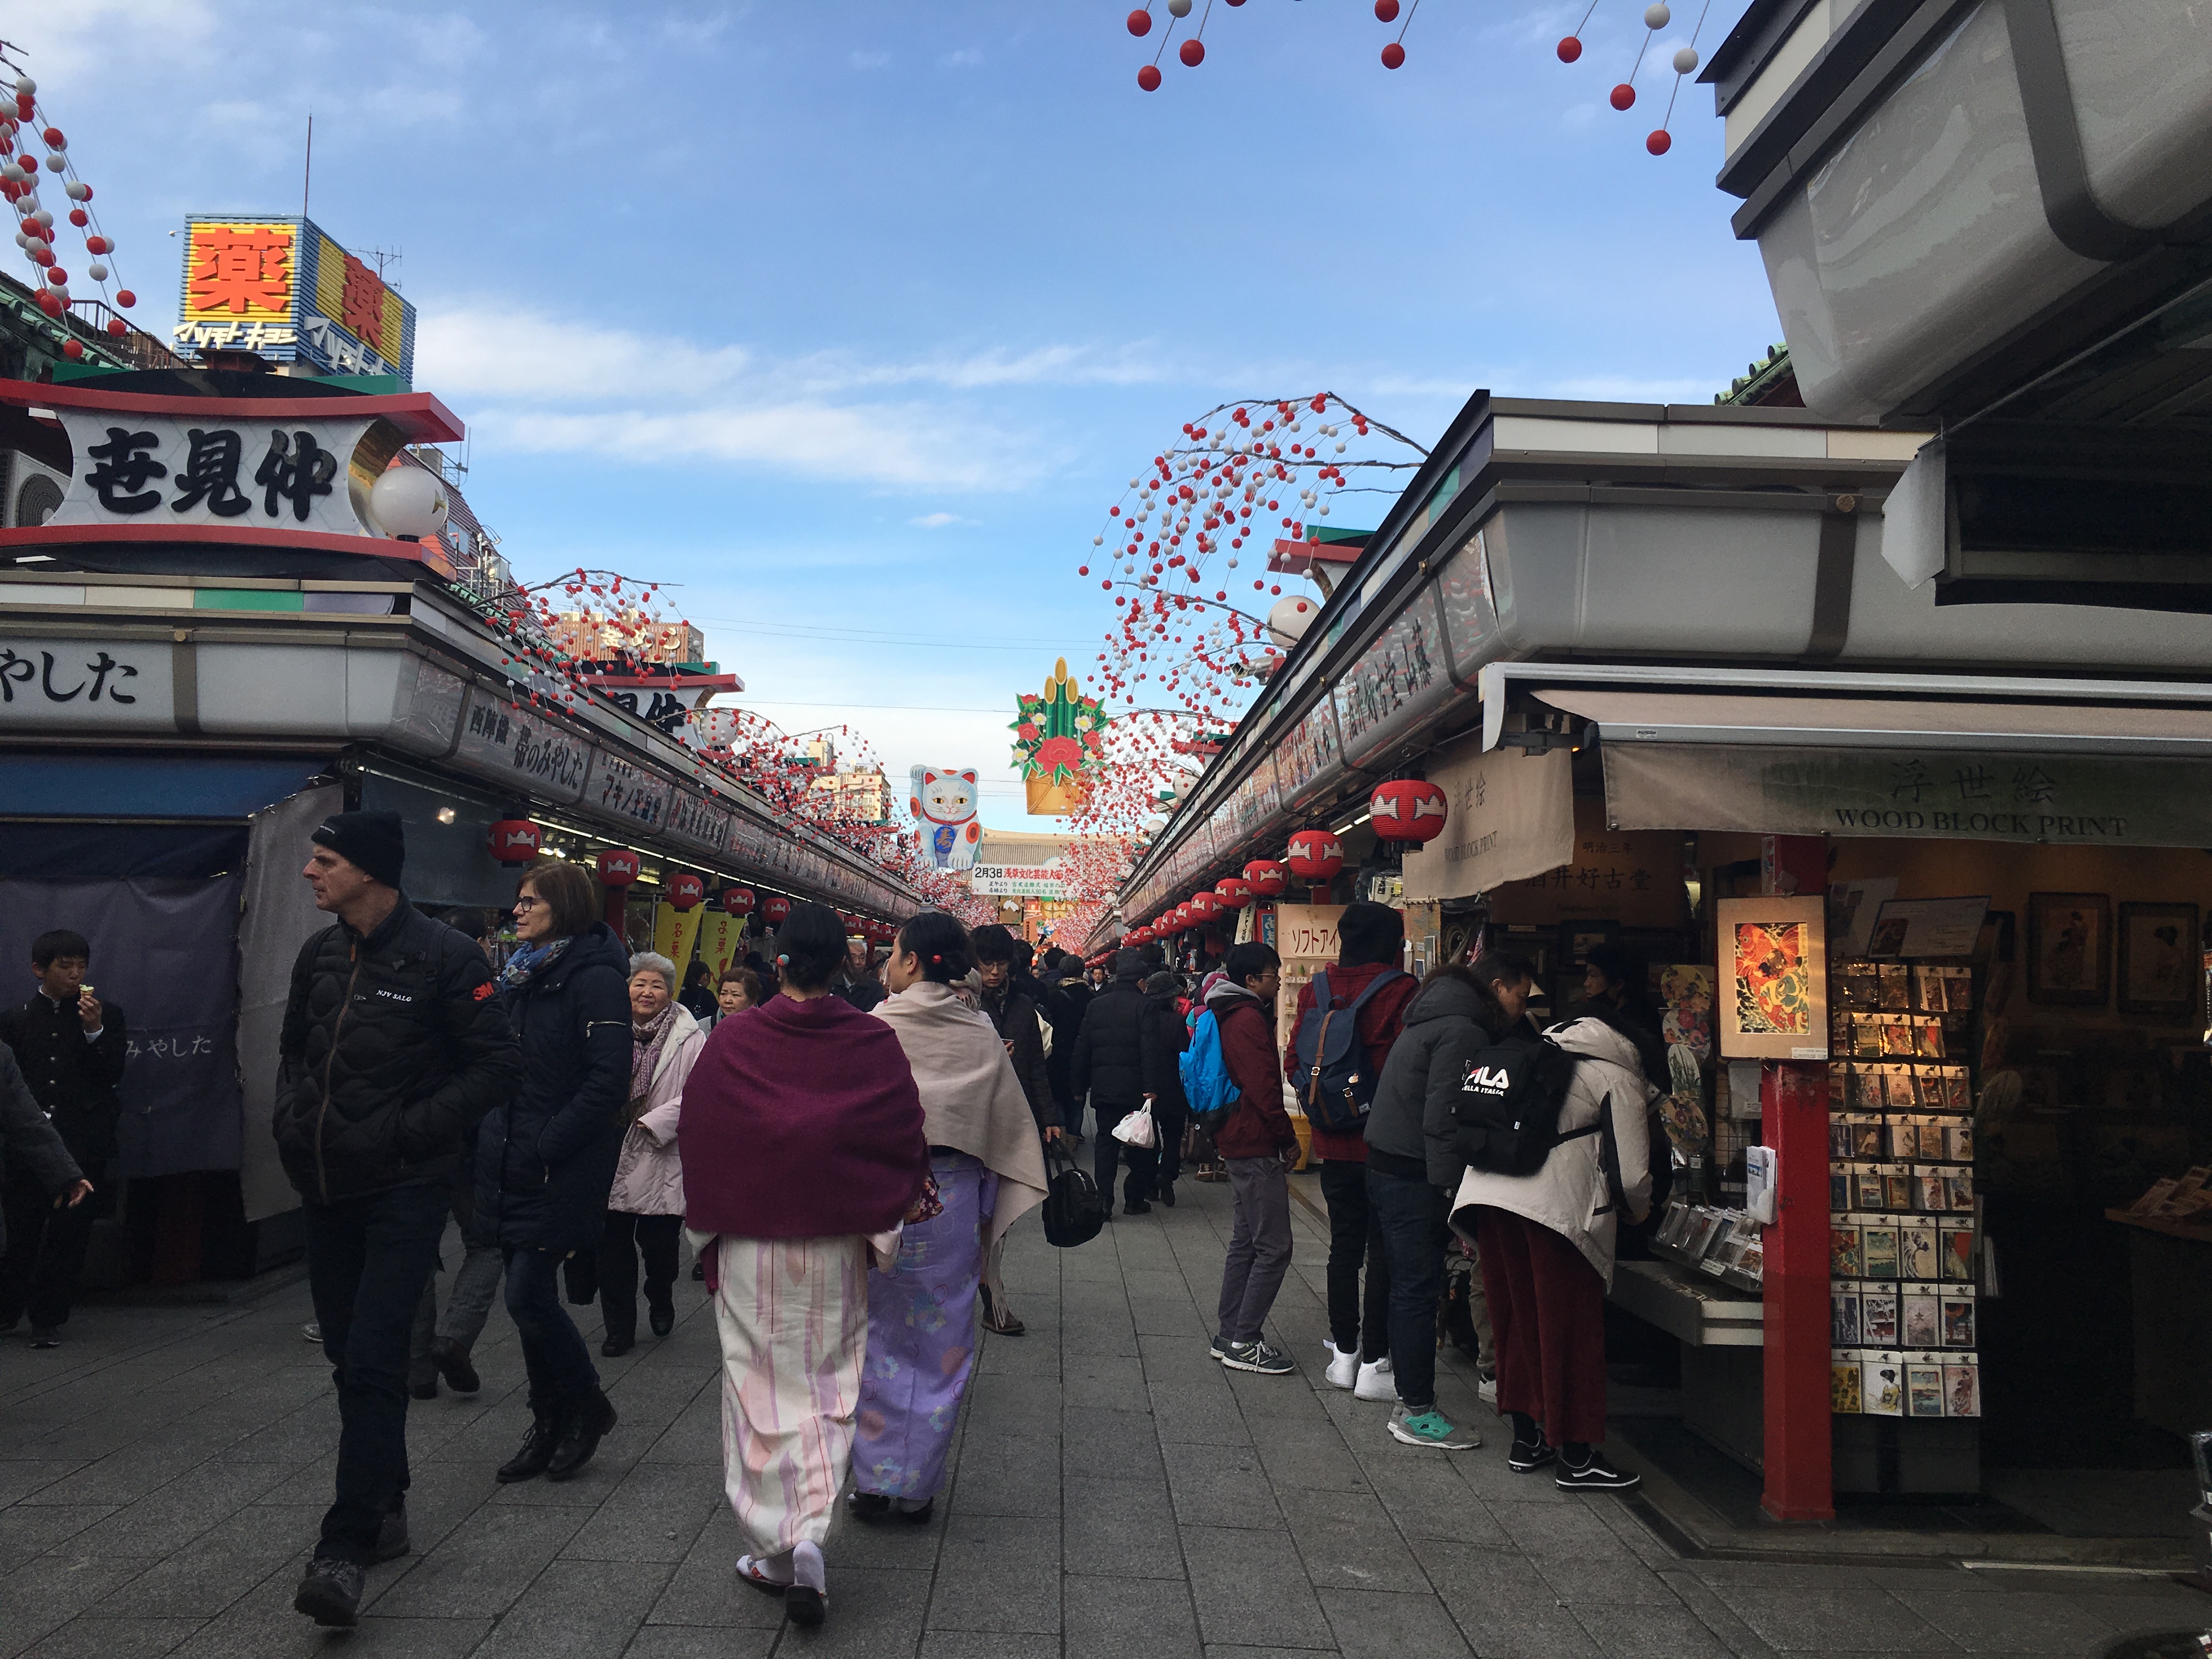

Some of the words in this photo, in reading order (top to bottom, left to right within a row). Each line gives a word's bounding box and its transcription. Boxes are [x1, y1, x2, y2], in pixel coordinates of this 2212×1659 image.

[189, 228, 291, 312] 薬
[342, 253, 385, 350] 薬
[173, 320, 298, 349] マツモトキヨシ
[1889, 759, 2057, 804] 浮世絵
[1835, 809, 1925, 829] WOOD
[1933, 812, 2031, 834] BLOCK
[2038, 815, 2128, 837] PRINT
[1583, 842, 1633, 855] 明治三年
[975, 867, 1003, 878] 2月3日
[1292, 928, 1338, 954] ソフトアイ
